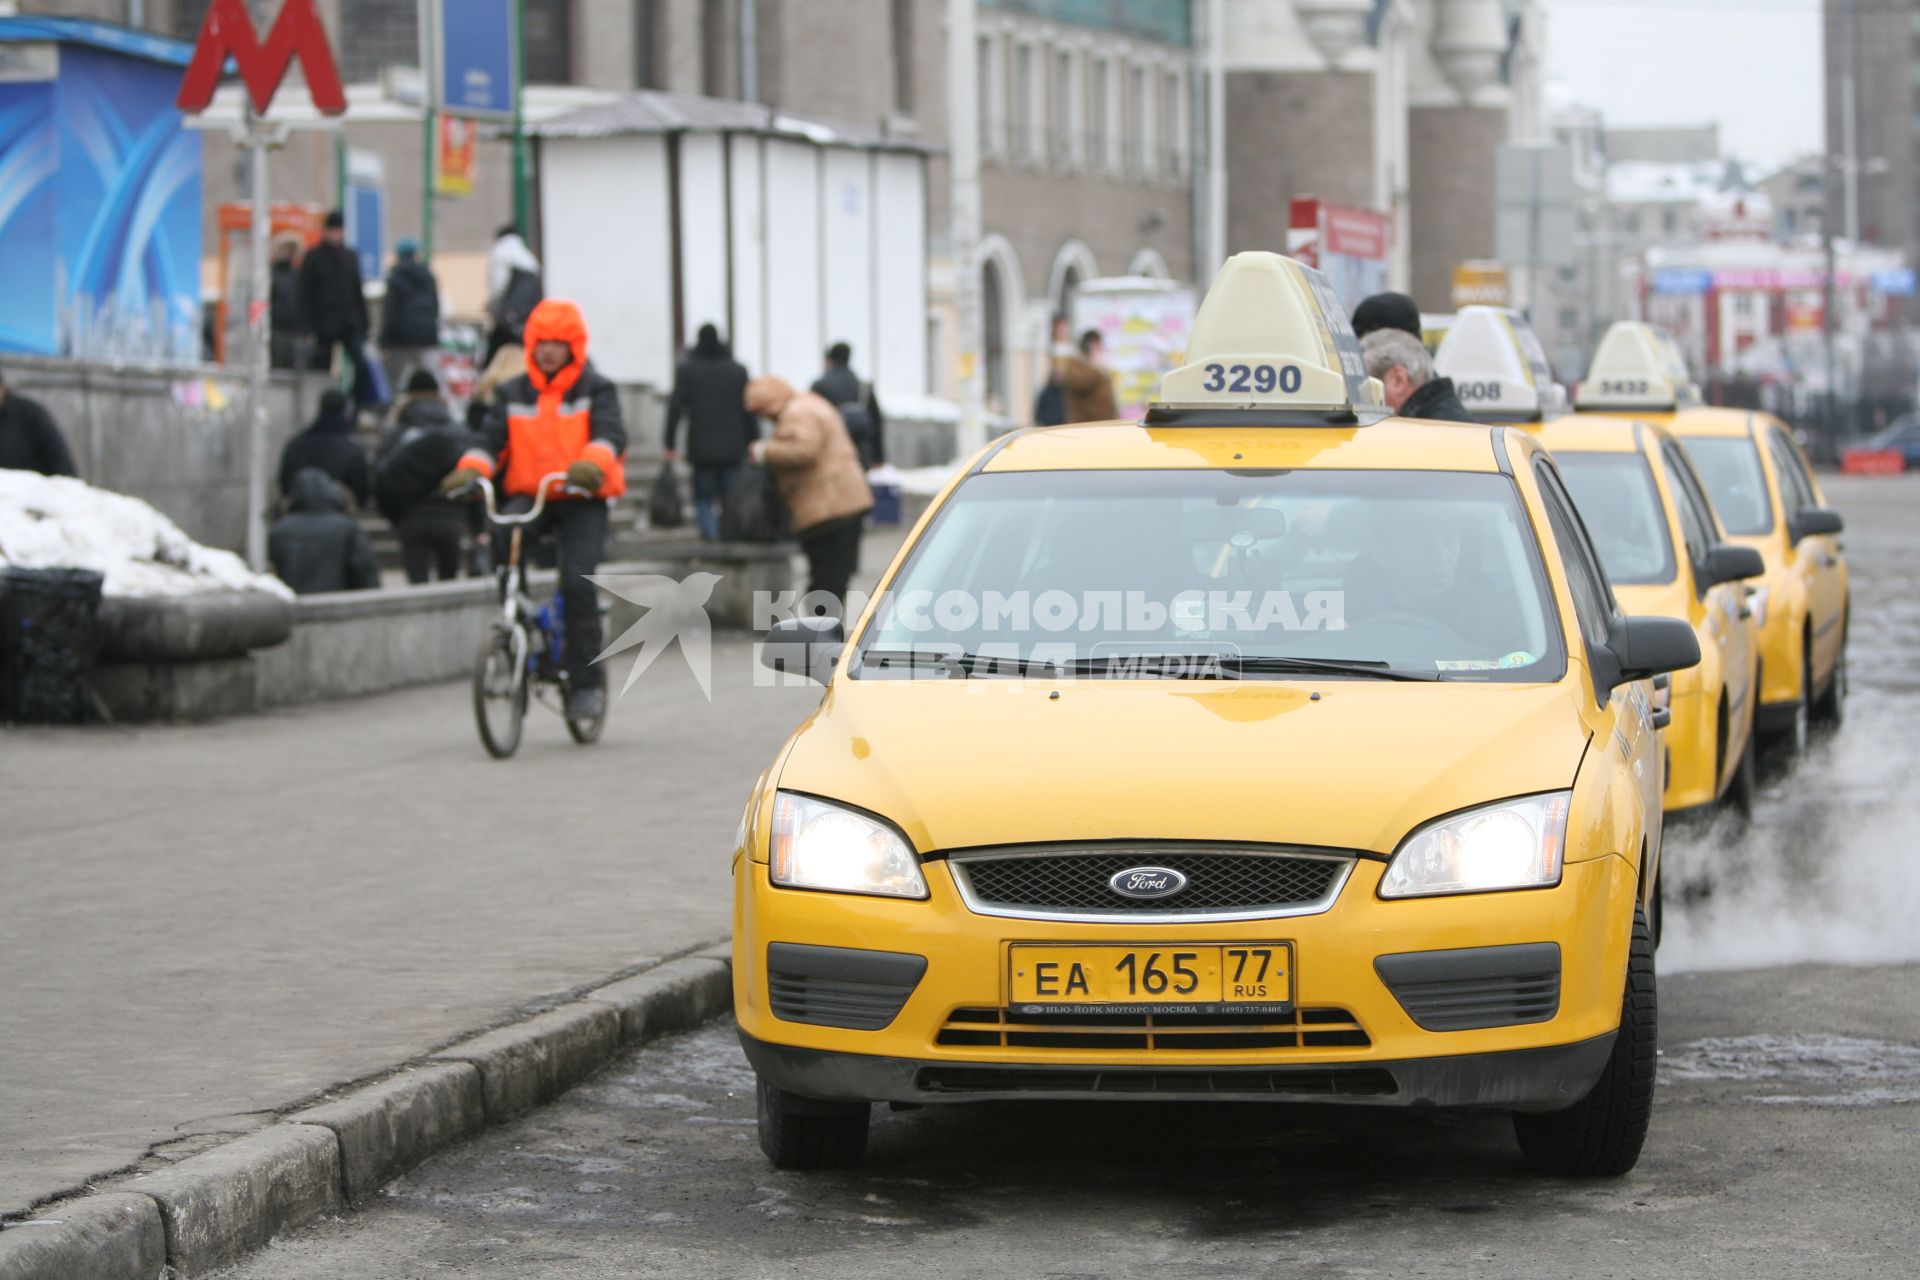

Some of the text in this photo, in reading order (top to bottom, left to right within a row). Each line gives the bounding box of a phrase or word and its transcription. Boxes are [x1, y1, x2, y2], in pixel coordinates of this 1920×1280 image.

[1203, 364, 1302, 393] 3290
[1127, 872, 1168, 889] Ford
[1115, 952, 1199, 996] 165
[1227, 949, 1272, 983] 77
[1234, 984, 1268, 998] RUS
[1222, 1005, 1243, 1016] (495)
